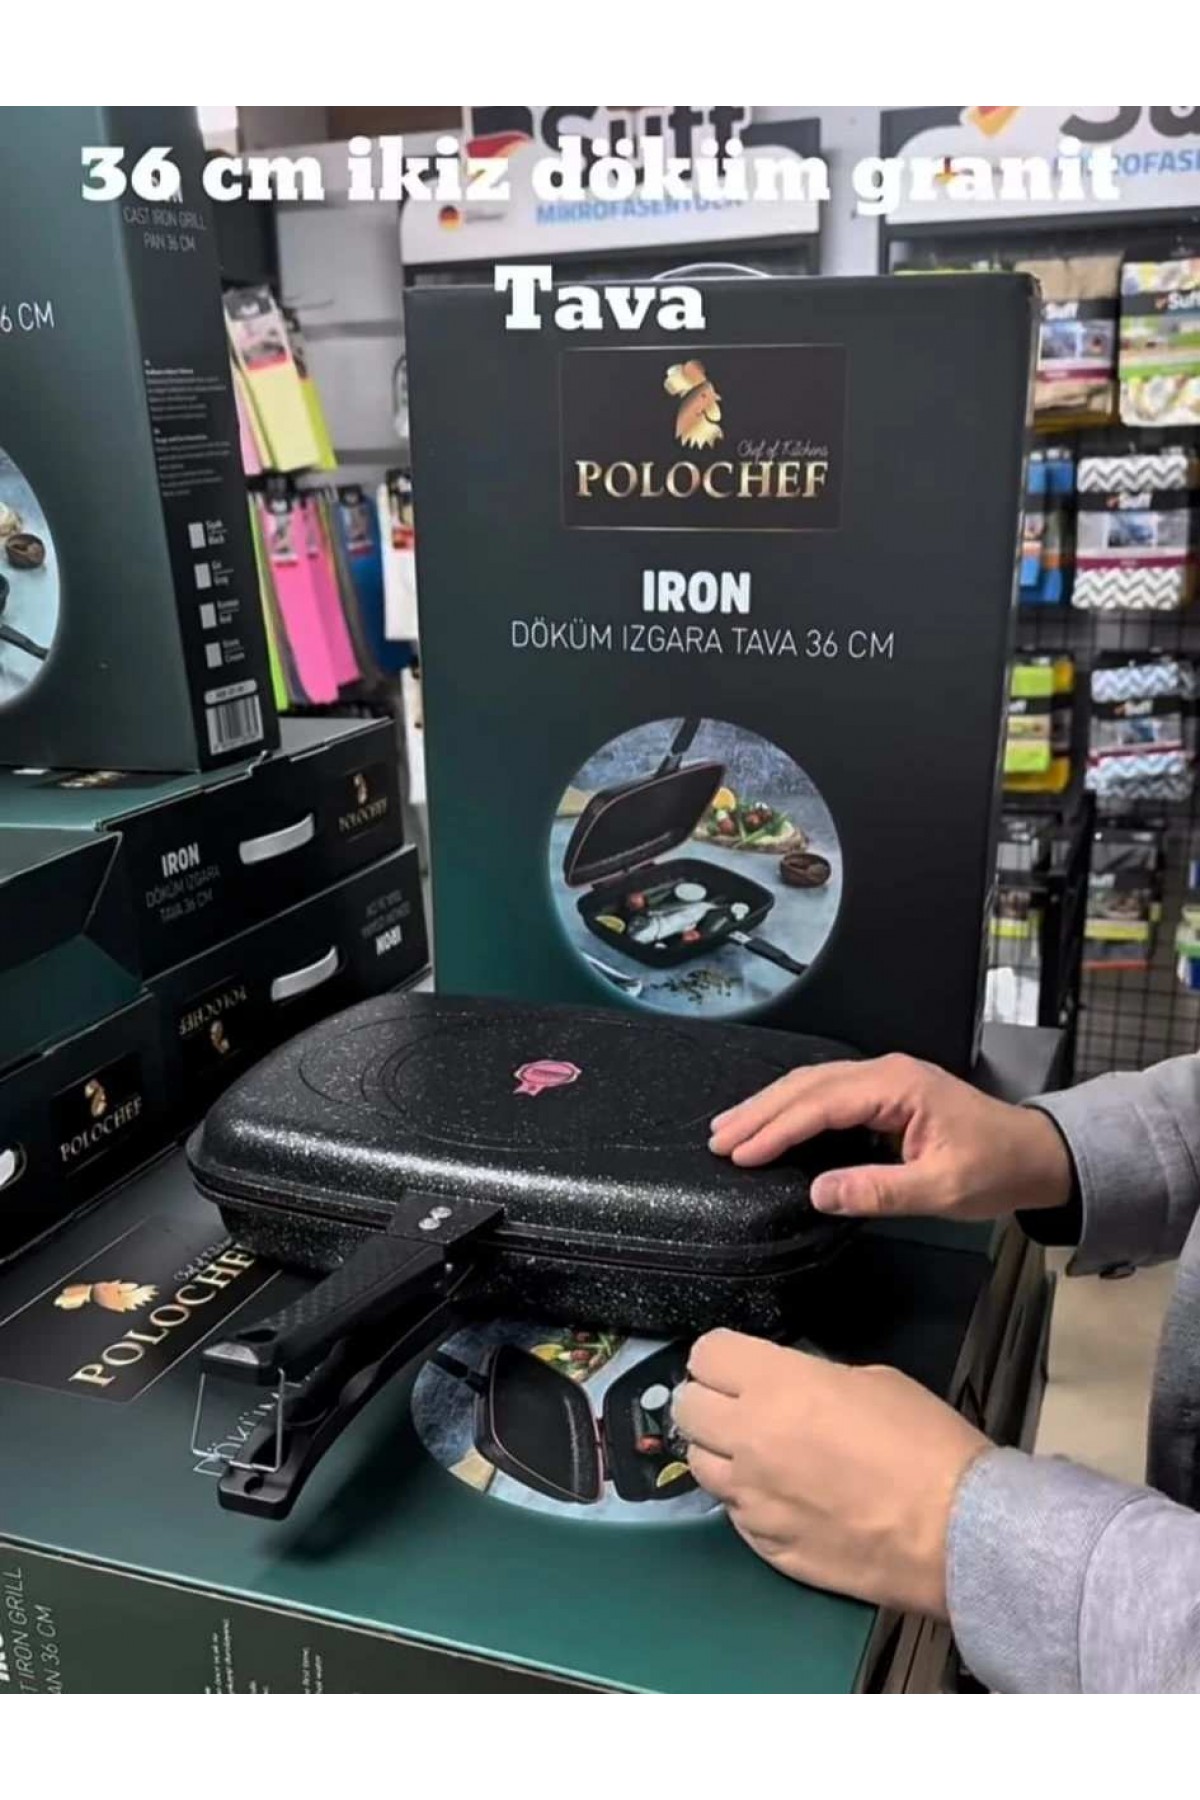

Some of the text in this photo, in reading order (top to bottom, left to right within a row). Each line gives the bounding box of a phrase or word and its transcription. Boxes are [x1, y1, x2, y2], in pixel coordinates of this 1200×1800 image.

[18, 300, 55, 331] CM
[574, 459, 829, 498] POLOCHEF
[642, 569, 752, 614] IRON
[511, 616, 895, 659] DÖKÜM IZGARA TAVA 36 CM
[161, 841, 201, 878] IRON
[60, 1096, 143, 1162] POLOCHEF
[2, 1567, 28, 1626] GRILL
[34, 1604, 57, 1638] CM
[12, 1629, 36, 1680] IRON
[40, 1642, 61, 1667] 36
